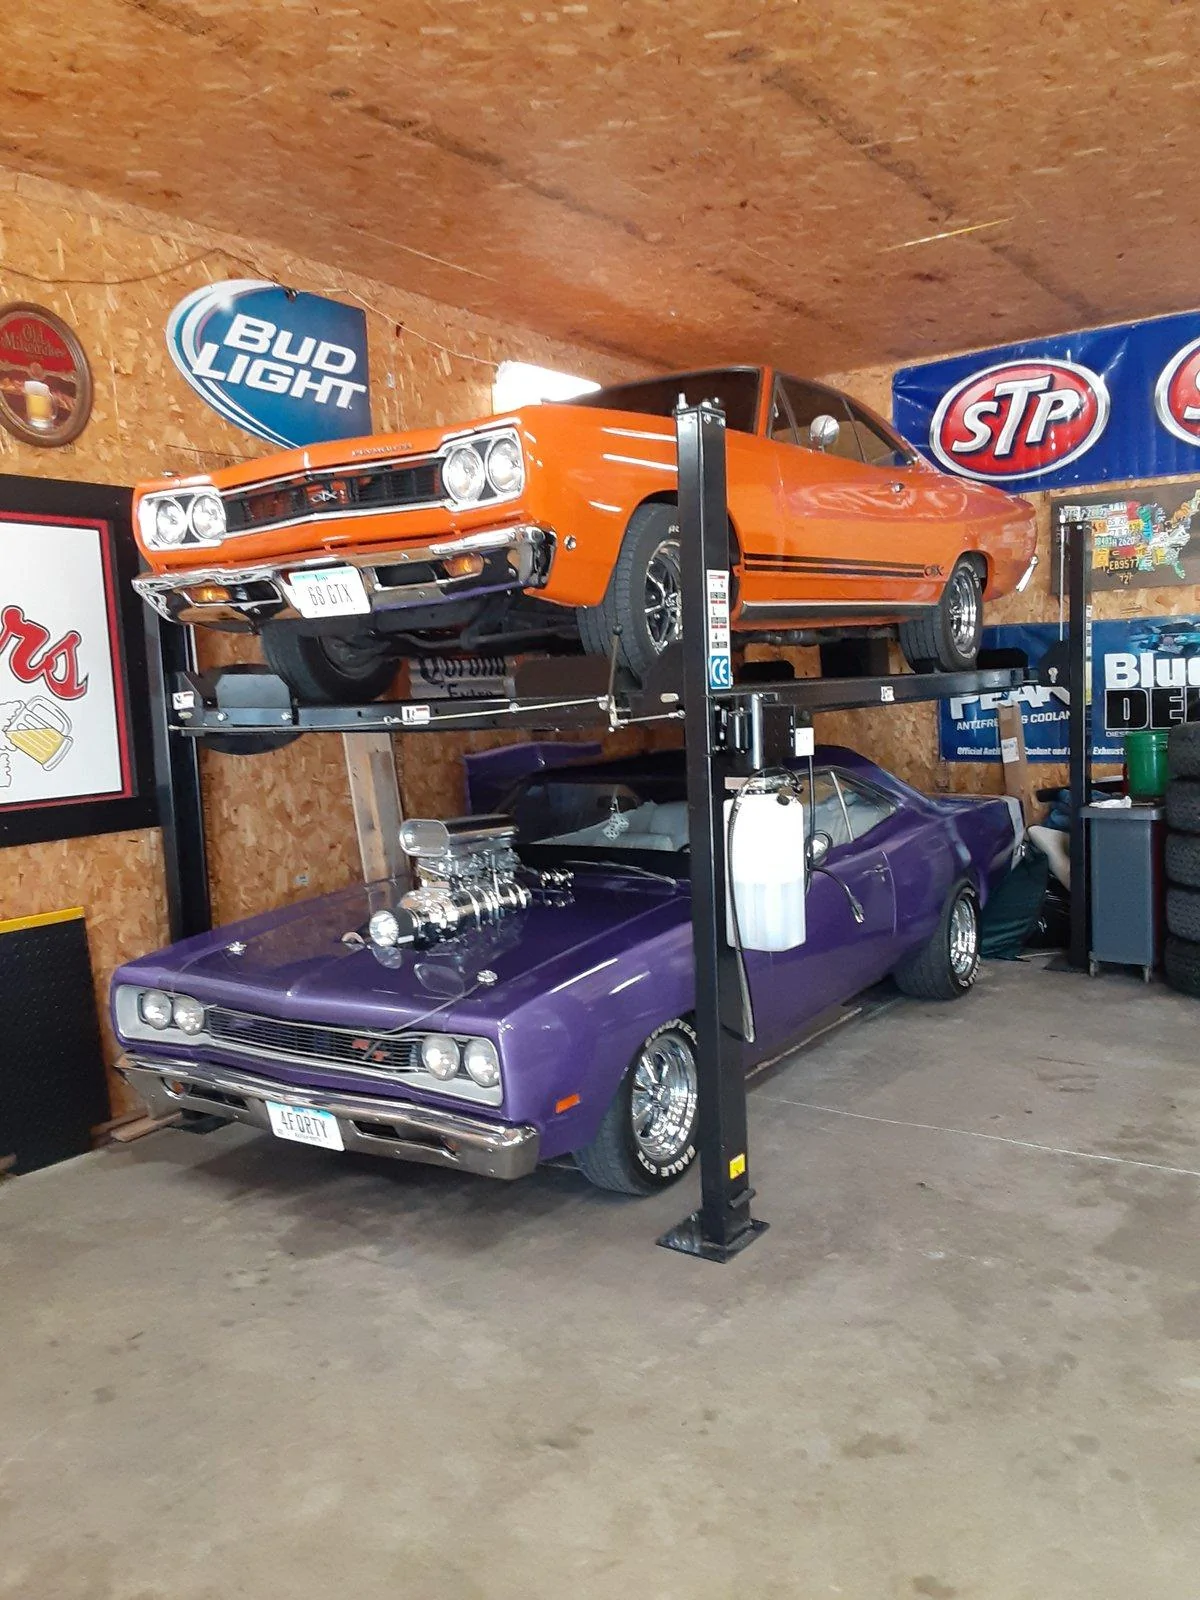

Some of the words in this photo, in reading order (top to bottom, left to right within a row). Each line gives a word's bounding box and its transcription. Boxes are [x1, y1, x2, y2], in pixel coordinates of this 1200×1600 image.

[192, 342, 367, 410] LIGHT
[223, 313, 357, 375] BUD
[951, 374, 1085, 457] STP
[327, 584, 353, 605] GTX
